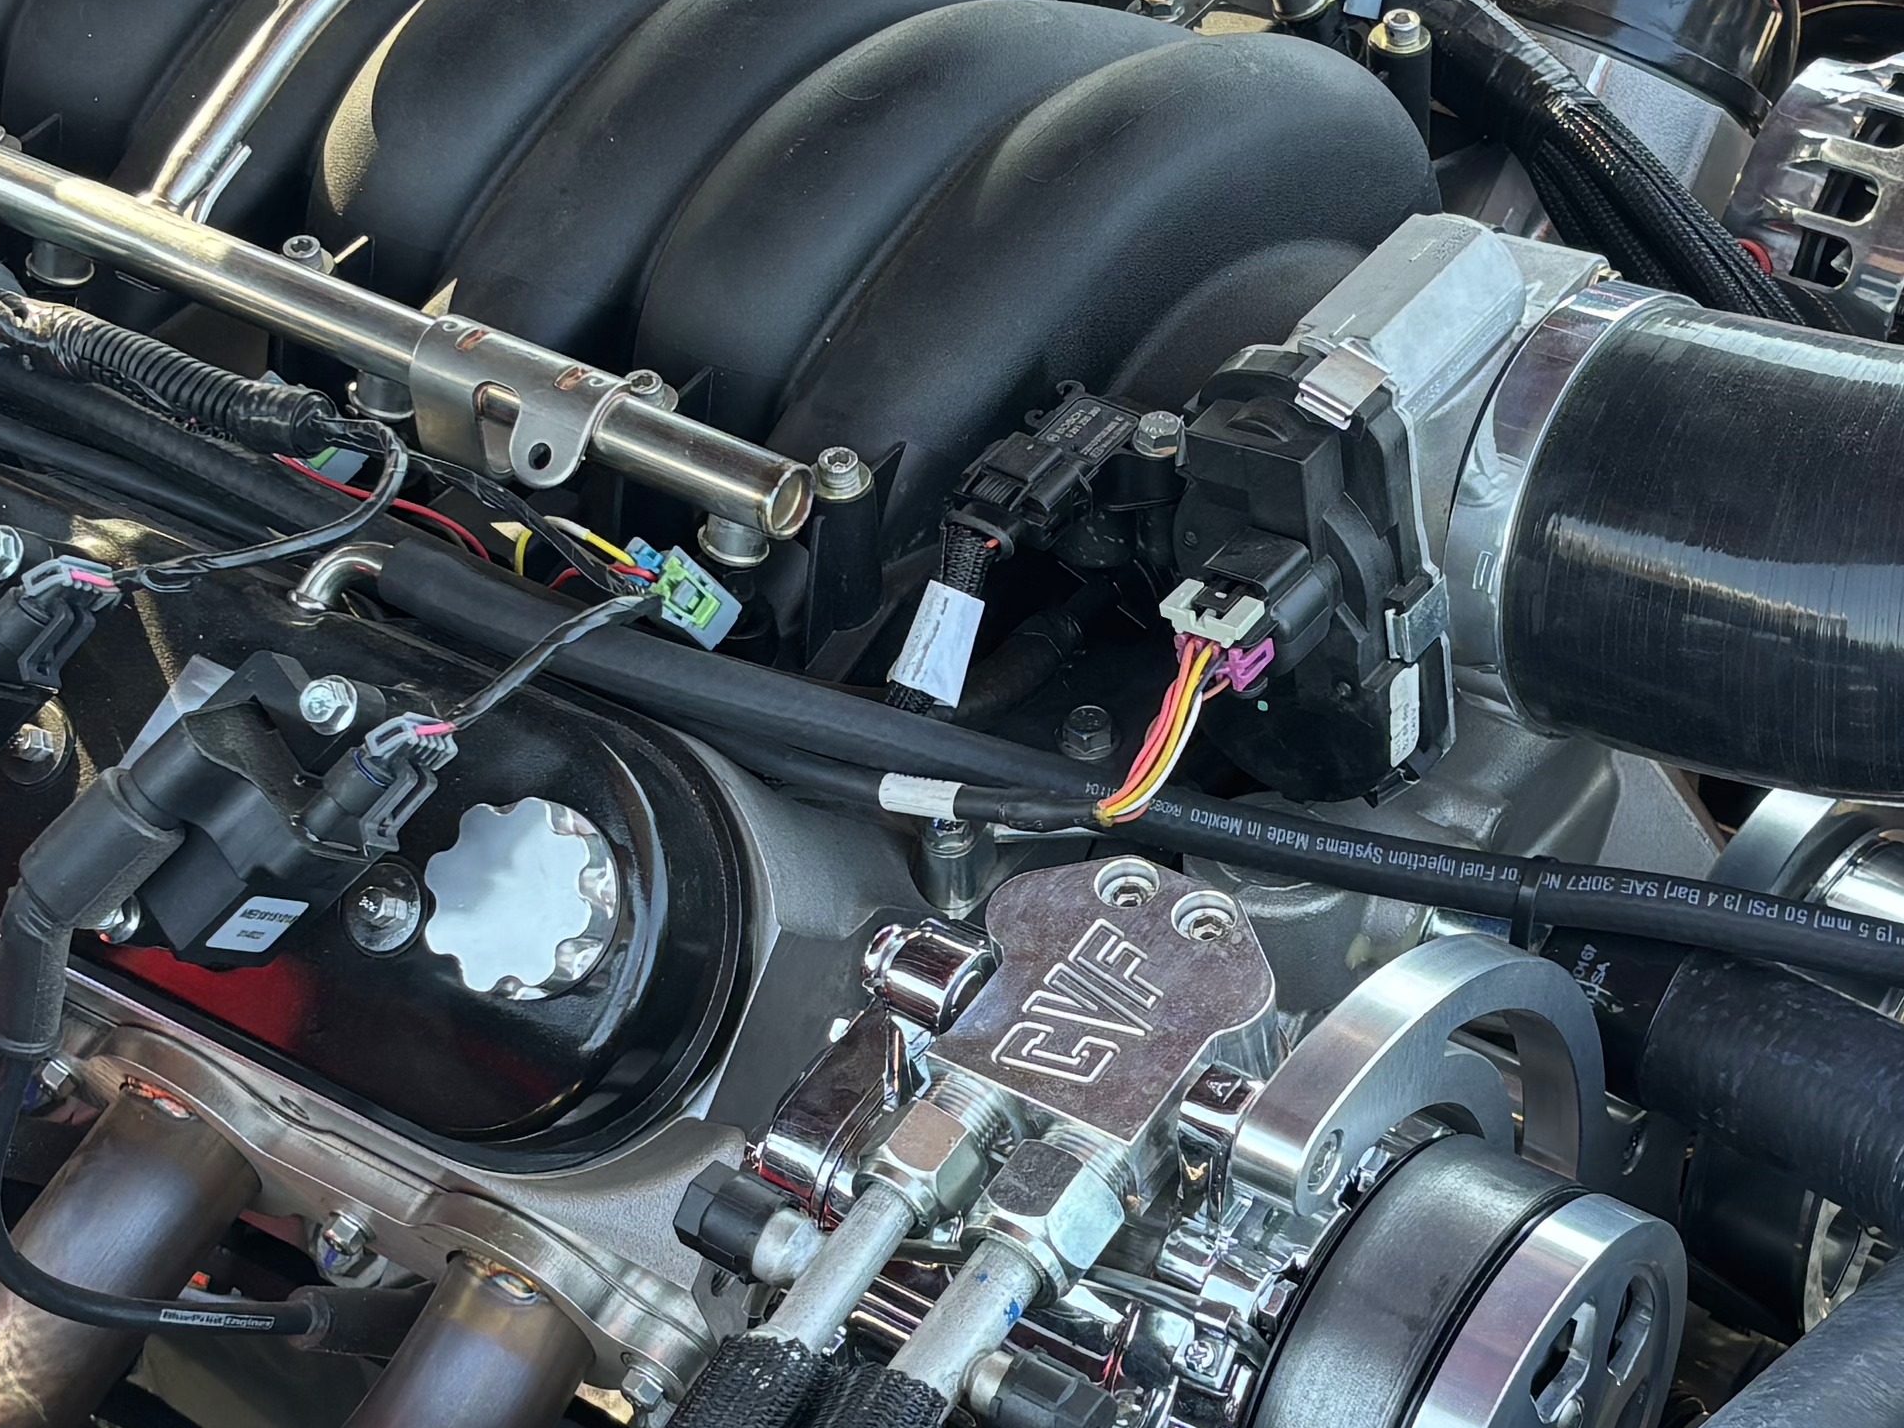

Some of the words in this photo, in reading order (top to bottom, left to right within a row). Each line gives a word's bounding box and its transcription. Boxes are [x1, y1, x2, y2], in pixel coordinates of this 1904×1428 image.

[1189, 808, 1245, 837] Mexico
[1246, 819, 1263, 840] in
[1266, 825, 1310, 852] Made
[1315, 836, 1385, 865] Systems
[1387, 848, 1457, 878] Injection
[1459, 860, 1497, 883] Fuel
[1499, 866, 1522, 885] or
[1566, 874, 1615, 893] 30R7
[1619, 877, 1659, 899] SAE
[1747, 899, 1779, 920] PSI
[1785, 905, 1809, 926] 50
[991, 918, 1165, 1084] CVF
